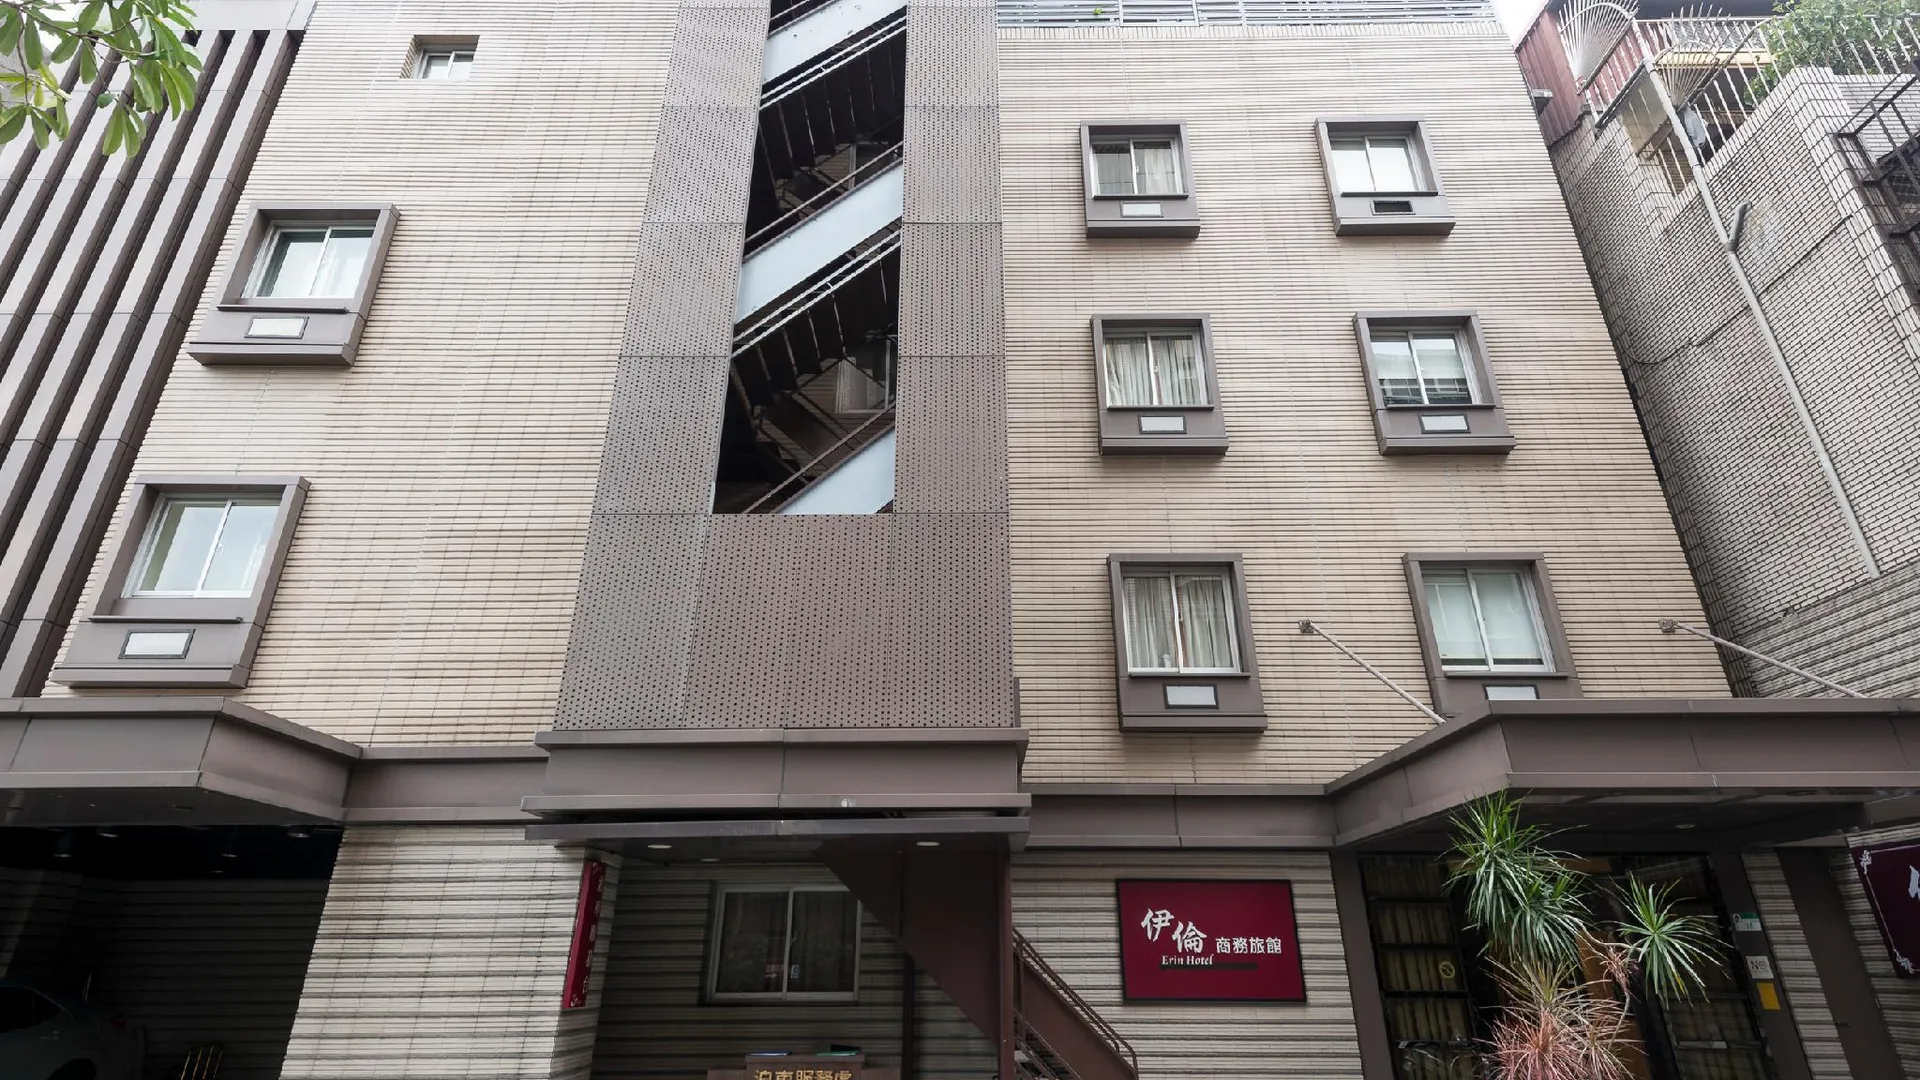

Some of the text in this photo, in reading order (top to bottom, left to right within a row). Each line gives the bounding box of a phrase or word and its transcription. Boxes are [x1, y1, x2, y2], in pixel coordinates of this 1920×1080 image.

[1141, 908, 1282, 954] 伊倫 商務旅館
[1161, 954, 1214, 966] Erin Hotel
